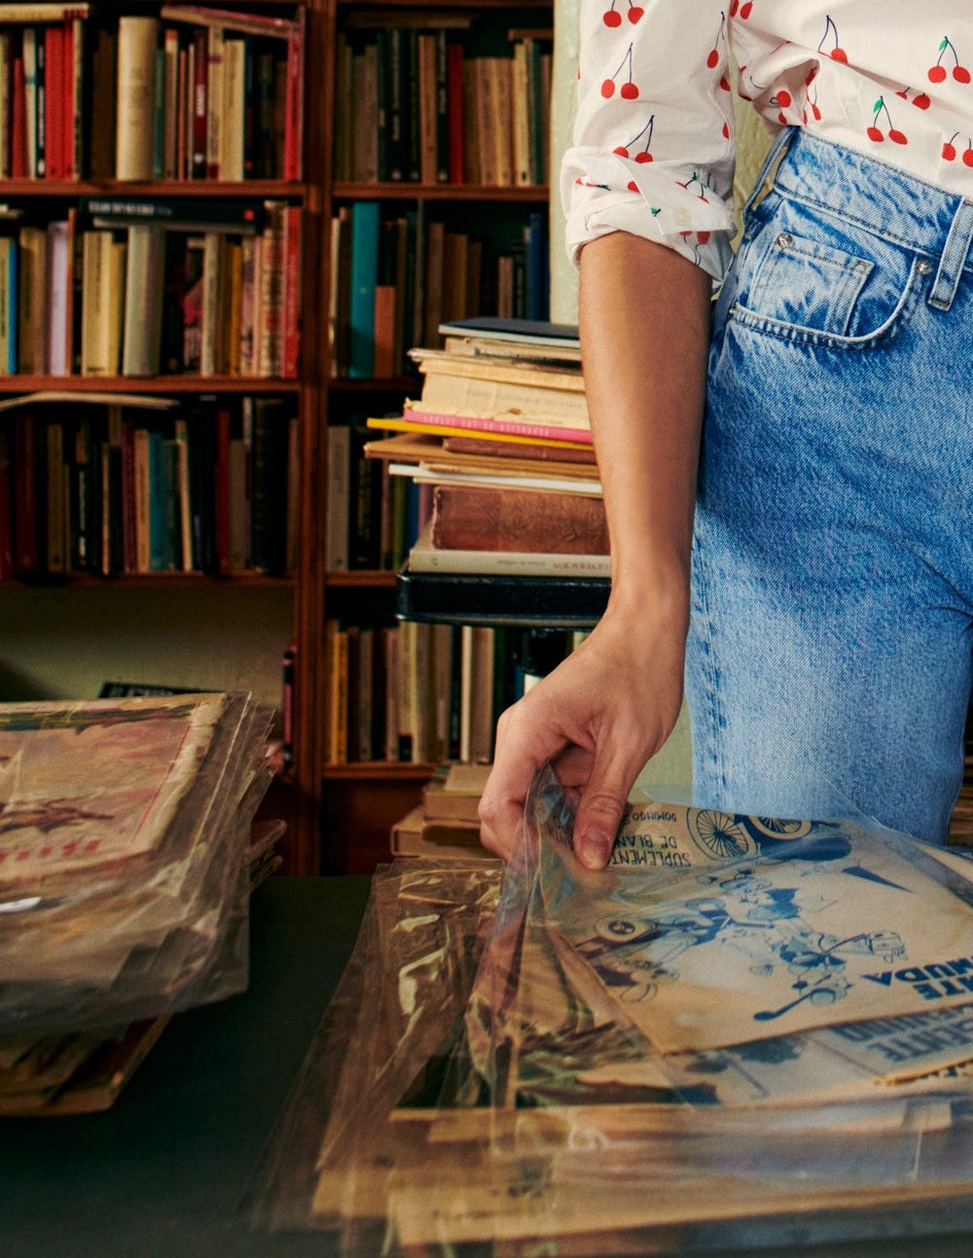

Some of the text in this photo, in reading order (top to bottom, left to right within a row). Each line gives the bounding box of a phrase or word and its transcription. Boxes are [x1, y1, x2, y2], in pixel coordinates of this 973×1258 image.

[631, 811, 677, 824] DOMINGO
[614, 834, 677, 850] DE BLAN
[609, 849, 692, 868] SUPLEMENT
